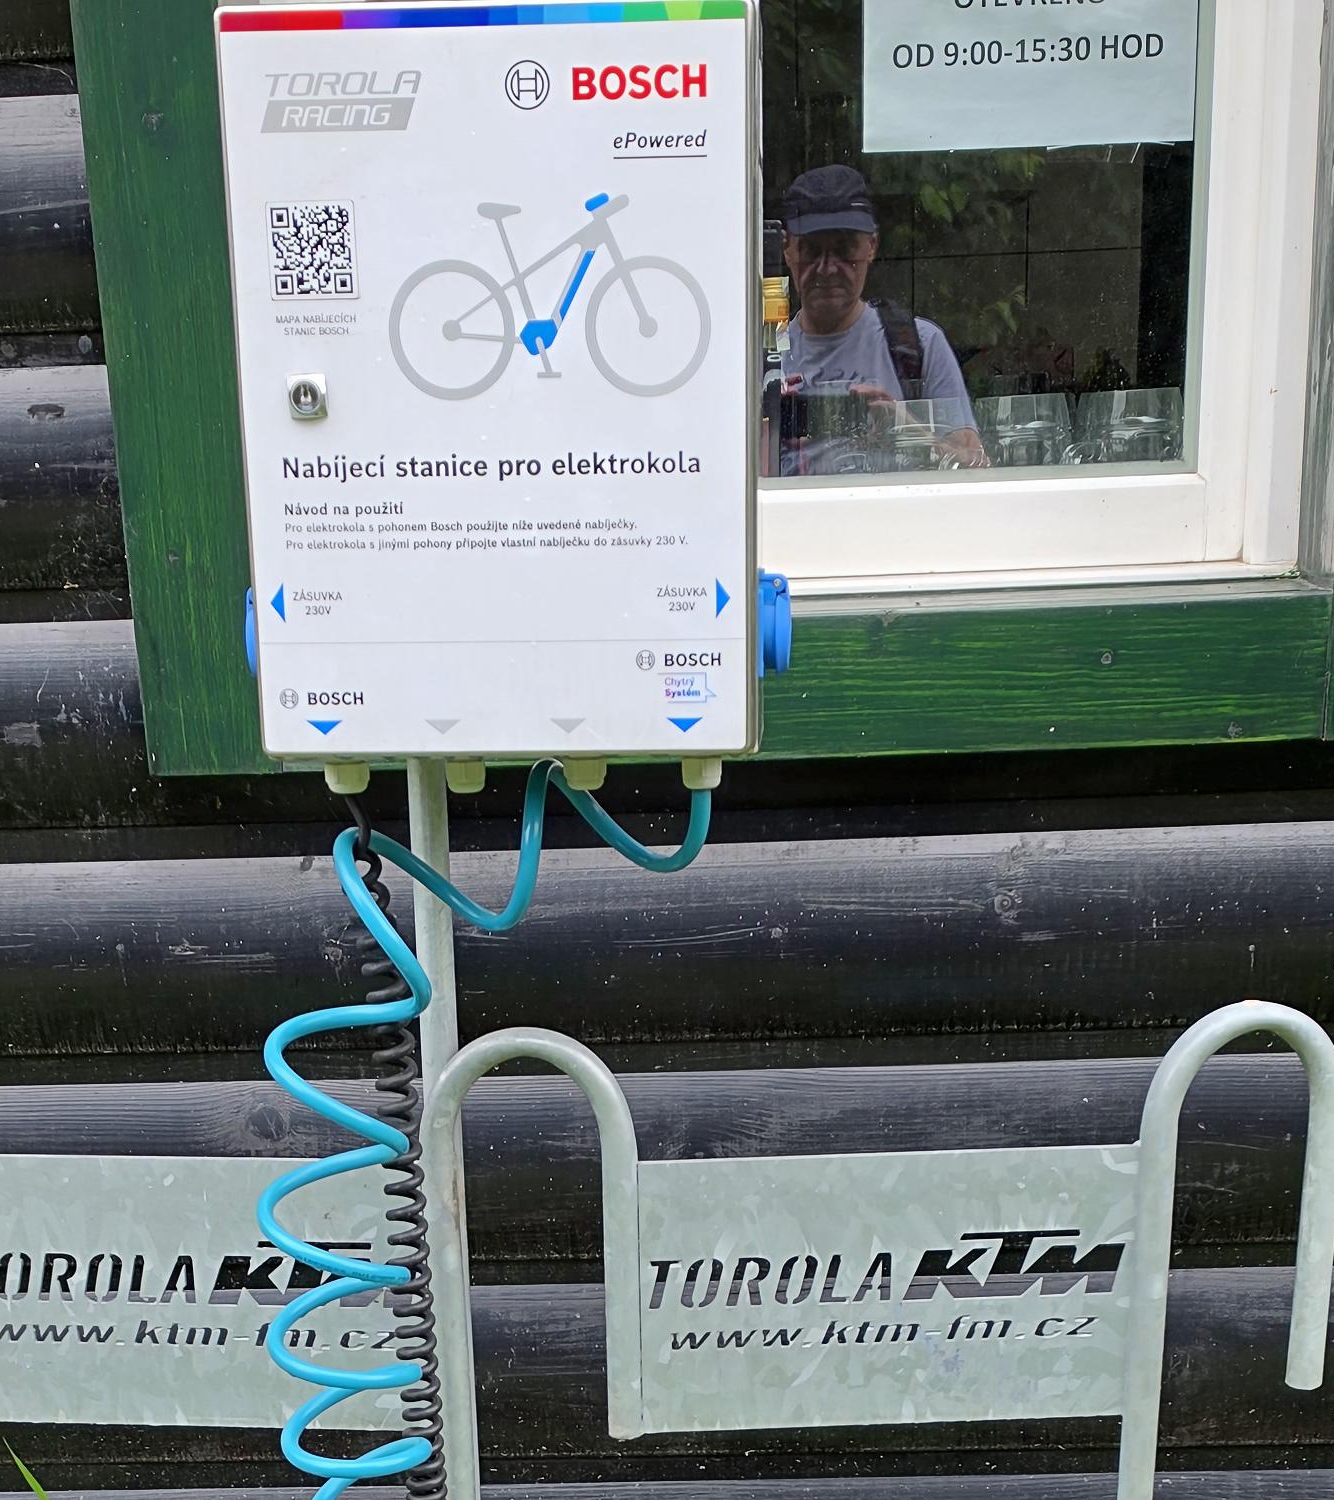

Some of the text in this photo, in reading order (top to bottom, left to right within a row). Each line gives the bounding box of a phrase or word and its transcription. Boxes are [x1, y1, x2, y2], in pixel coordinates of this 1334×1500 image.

[892, 33, 1164, 68] OD 9:00-15:30 HOD
[266, 70, 421, 97] TOROLA
[571, 64, 708, 101] BOSCH
[281, 103, 391, 127] RACING
[613, 129, 707, 150] ePowered
[275, 314, 300, 324] MAPA
[283, 326, 350, 336] STANIC BOSCH
[282, 451, 701, 483] Nabíjecí stanice pro elektrokola
[284, 501, 404, 518] Návod na použití
[285, 518, 637, 534] Pro elektrokola s pohonem Bosch použijte níže uvedené nabíječky.
[286, 535, 688, 551] Pro elektrokola s jinými pohony připojte vlastní nabíječku do zásuvky 230 V.
[292, 588, 343, 601] ZÁSUVKA
[656, 584, 708, 597] ZÁSUVKA
[305, 605, 332, 615] 230V
[669, 601, 696, 612] 230V
[664, 652, 722, 667] BOSCH
[664, 676, 695, 688] Chytrý
[307, 691, 364, 705] BOSCH
[665, 686, 701, 698] Systém
[648, 1228, 1127, 1309] TOROLA KTM
[671, 1314, 1099, 1350] www.ktm-fm.cz
